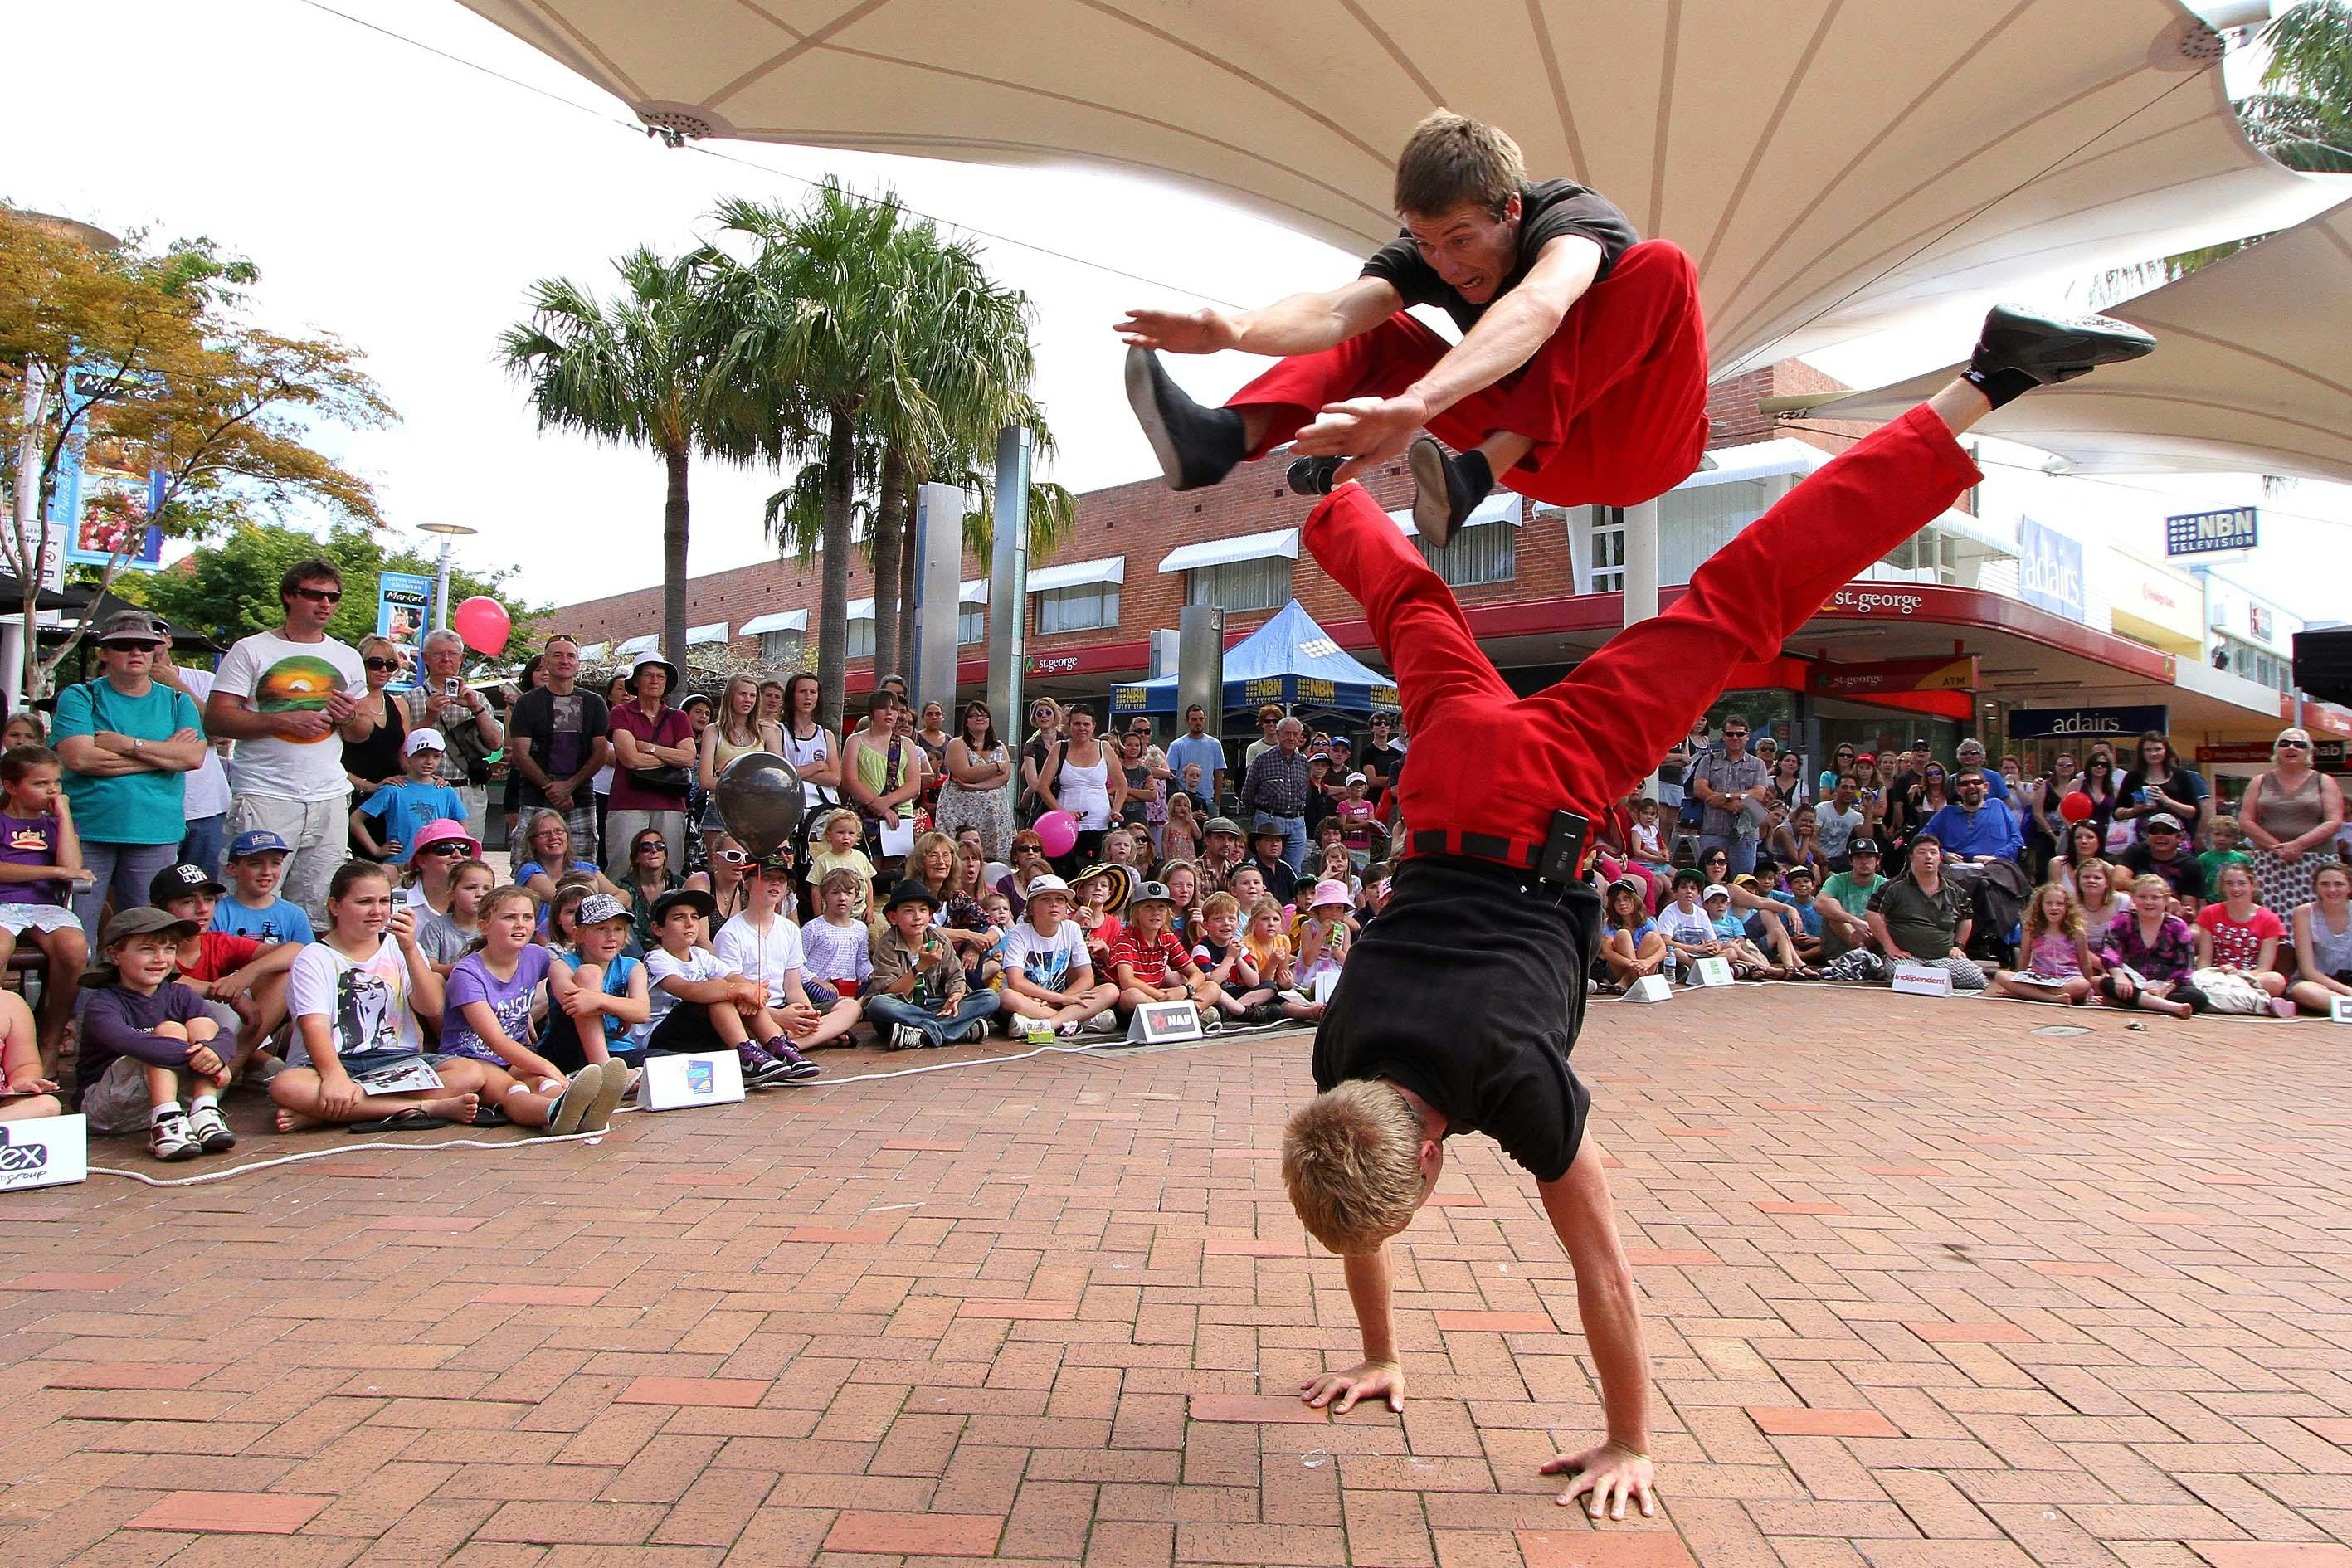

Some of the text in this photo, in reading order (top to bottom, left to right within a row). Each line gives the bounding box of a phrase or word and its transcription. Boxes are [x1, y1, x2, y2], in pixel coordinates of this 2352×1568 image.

[2197, 511, 2253, 539] NBN
[2171, 535, 2253, 552] TELEVISION
[2024, 537, 2082, 605] adairs
[386, 591, 424, 602] Market
[1834, 591, 1922, 614] st.george
[1039, 656, 1078, 673] st.george
[1258, 679, 1282, 696] NBN
[1310, 679, 1335, 698] NBN
[1833, 674, 1884, 688] st.george
[1942, 676, 1966, 686] ATM
[1127, 688, 1147, 703] NBN
[2053, 712, 2120, 732] adairs
[1895, 974, 1945, 984] Independent
[1167, 1014, 1192, 1026] NAB
